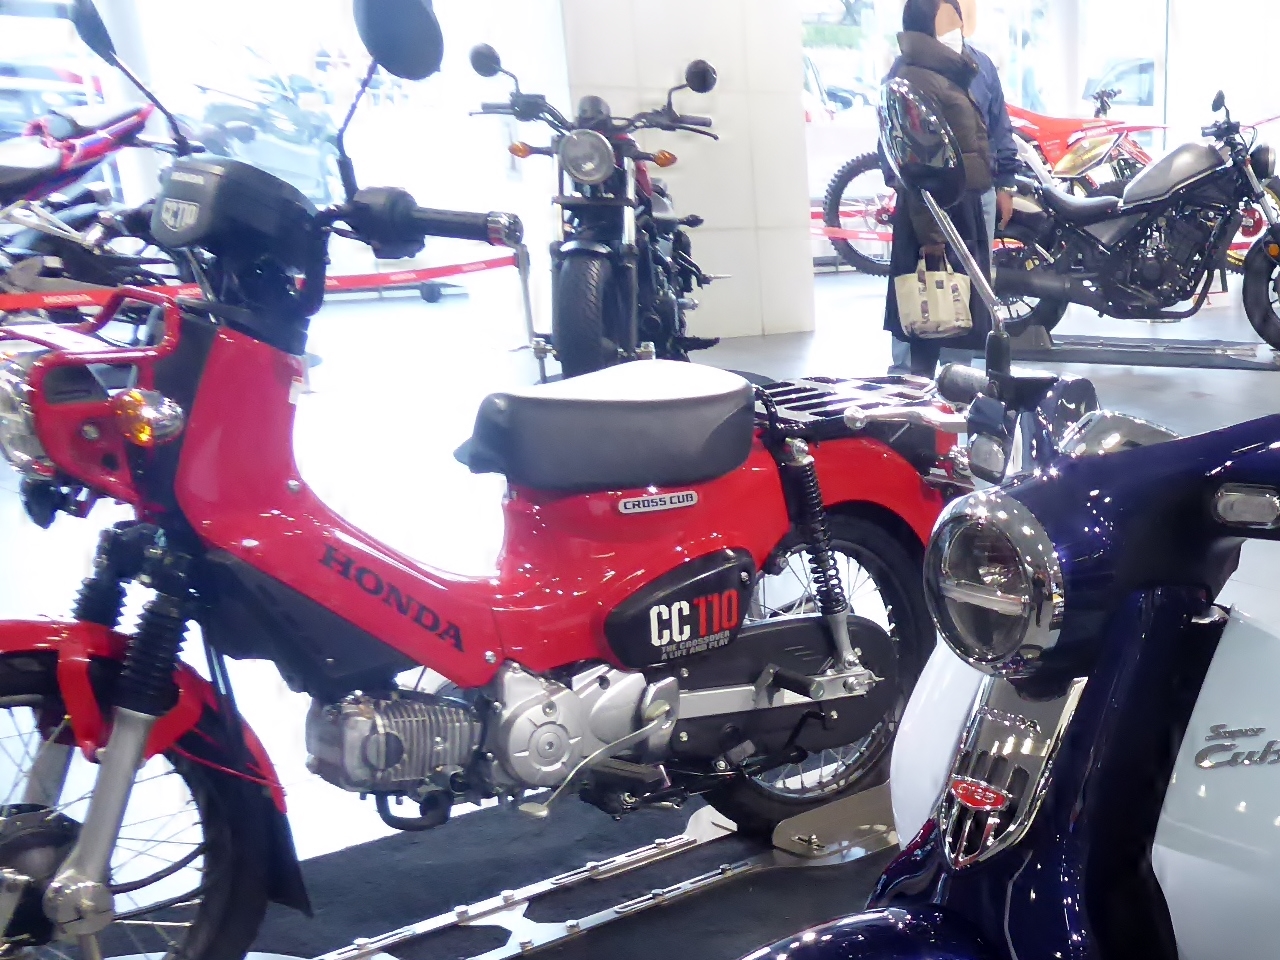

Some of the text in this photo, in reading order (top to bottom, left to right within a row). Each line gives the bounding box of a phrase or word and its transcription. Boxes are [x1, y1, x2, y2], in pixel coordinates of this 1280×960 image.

[623, 493, 694, 510] CROSS CUB
[318, 543, 465, 653] HONDA
[680, 629, 730, 649] CROSSOVER
[709, 636, 730, 649] PLAY
